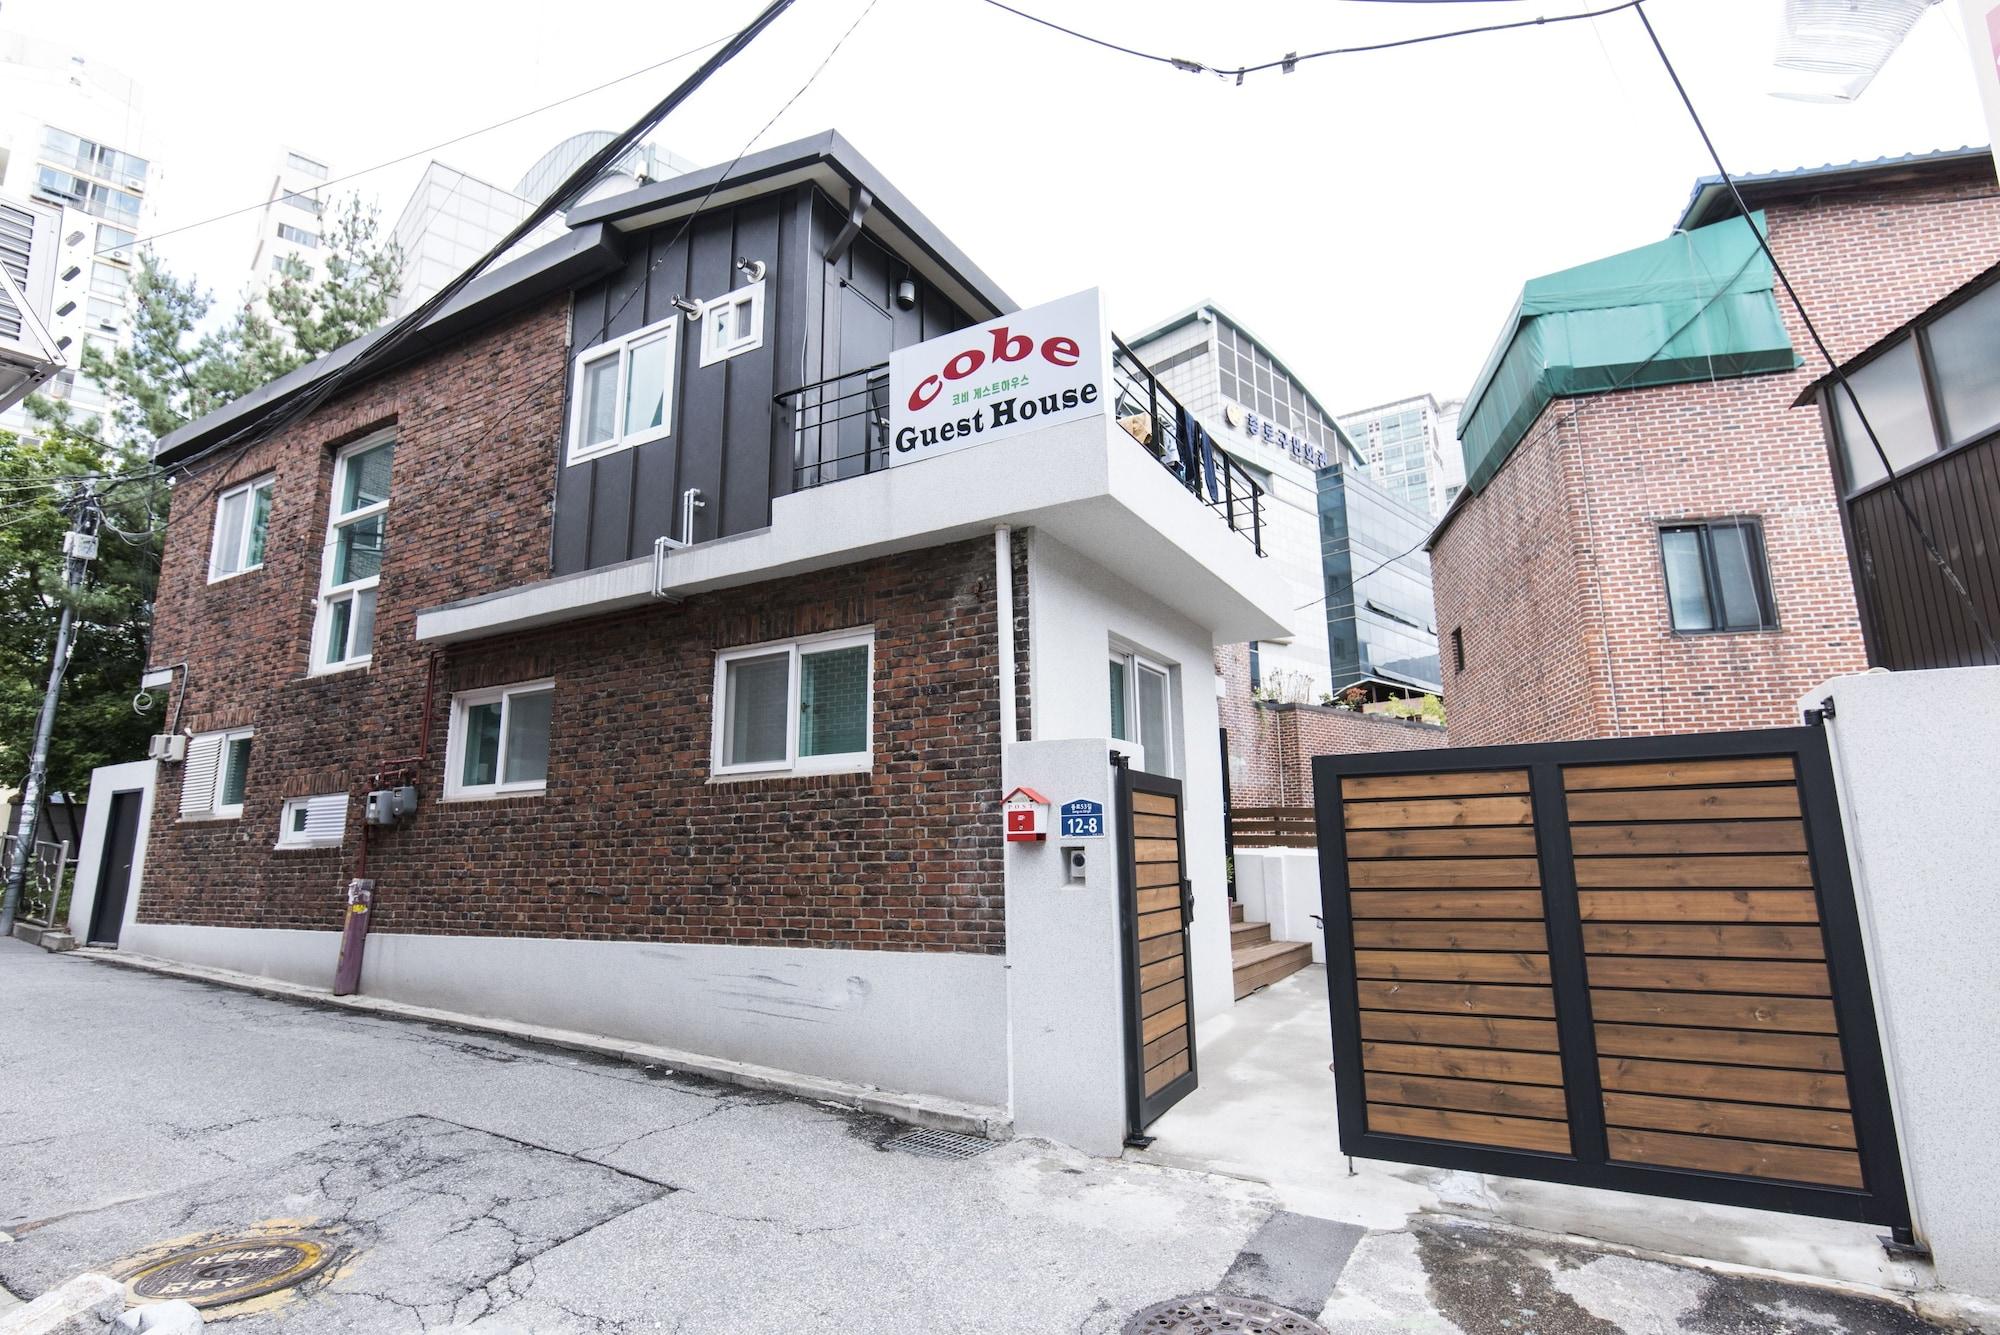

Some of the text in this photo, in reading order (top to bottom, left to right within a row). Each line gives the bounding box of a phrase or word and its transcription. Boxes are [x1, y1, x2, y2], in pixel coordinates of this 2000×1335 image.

[908, 327, 1080, 411] cobe
[952, 375, 1029, 406] 코비 게스트하우스
[896, 383, 1098, 453] Guest House
[1069, 818, 1097, 833] 12-8
[157, 1276, 253, 1294] 소화전
